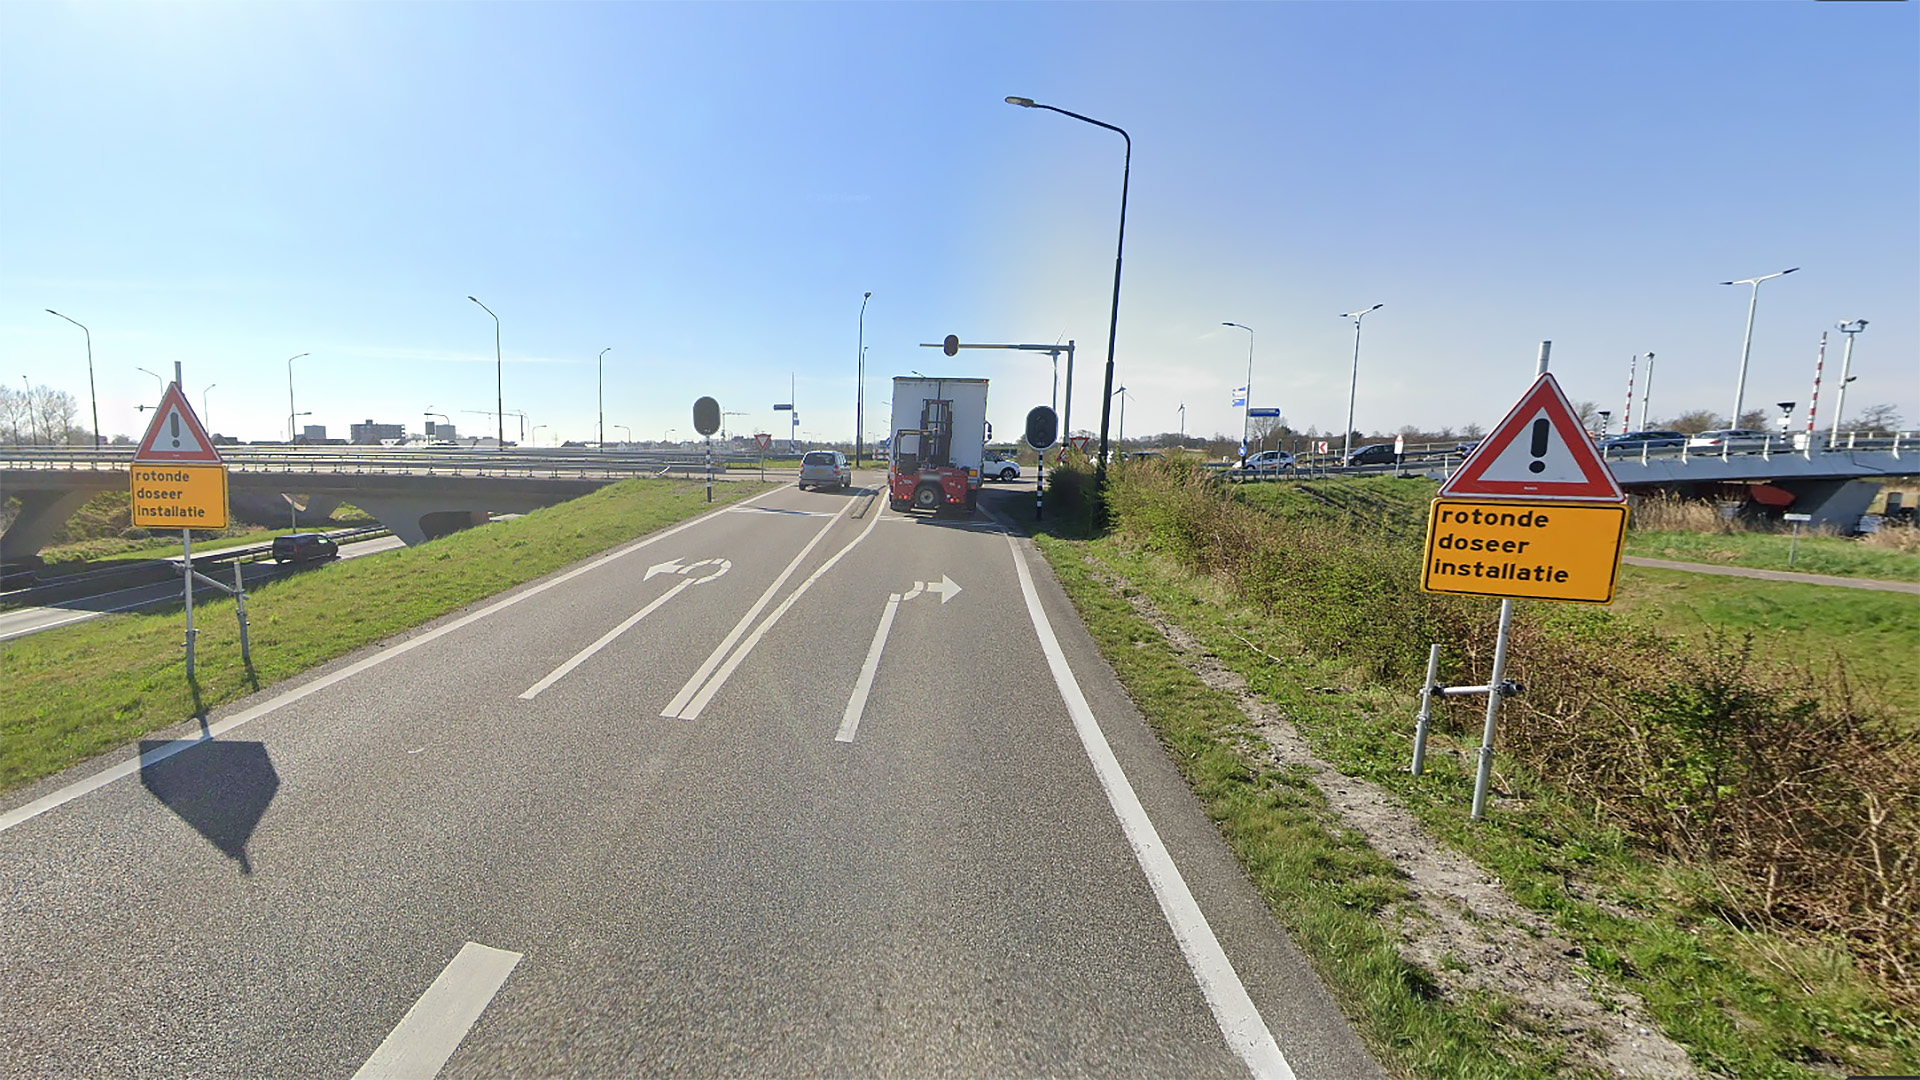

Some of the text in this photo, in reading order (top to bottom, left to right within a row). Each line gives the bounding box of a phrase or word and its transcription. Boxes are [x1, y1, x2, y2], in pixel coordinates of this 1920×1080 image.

[135, 470, 190, 482] rotonde
[136, 487, 183, 499] doseer
[137, 505, 205, 518] installatie
[1441, 508, 1549, 528] rotonde
[1438, 533, 1530, 553] doseer
[1434, 558, 1569, 583] installatie
